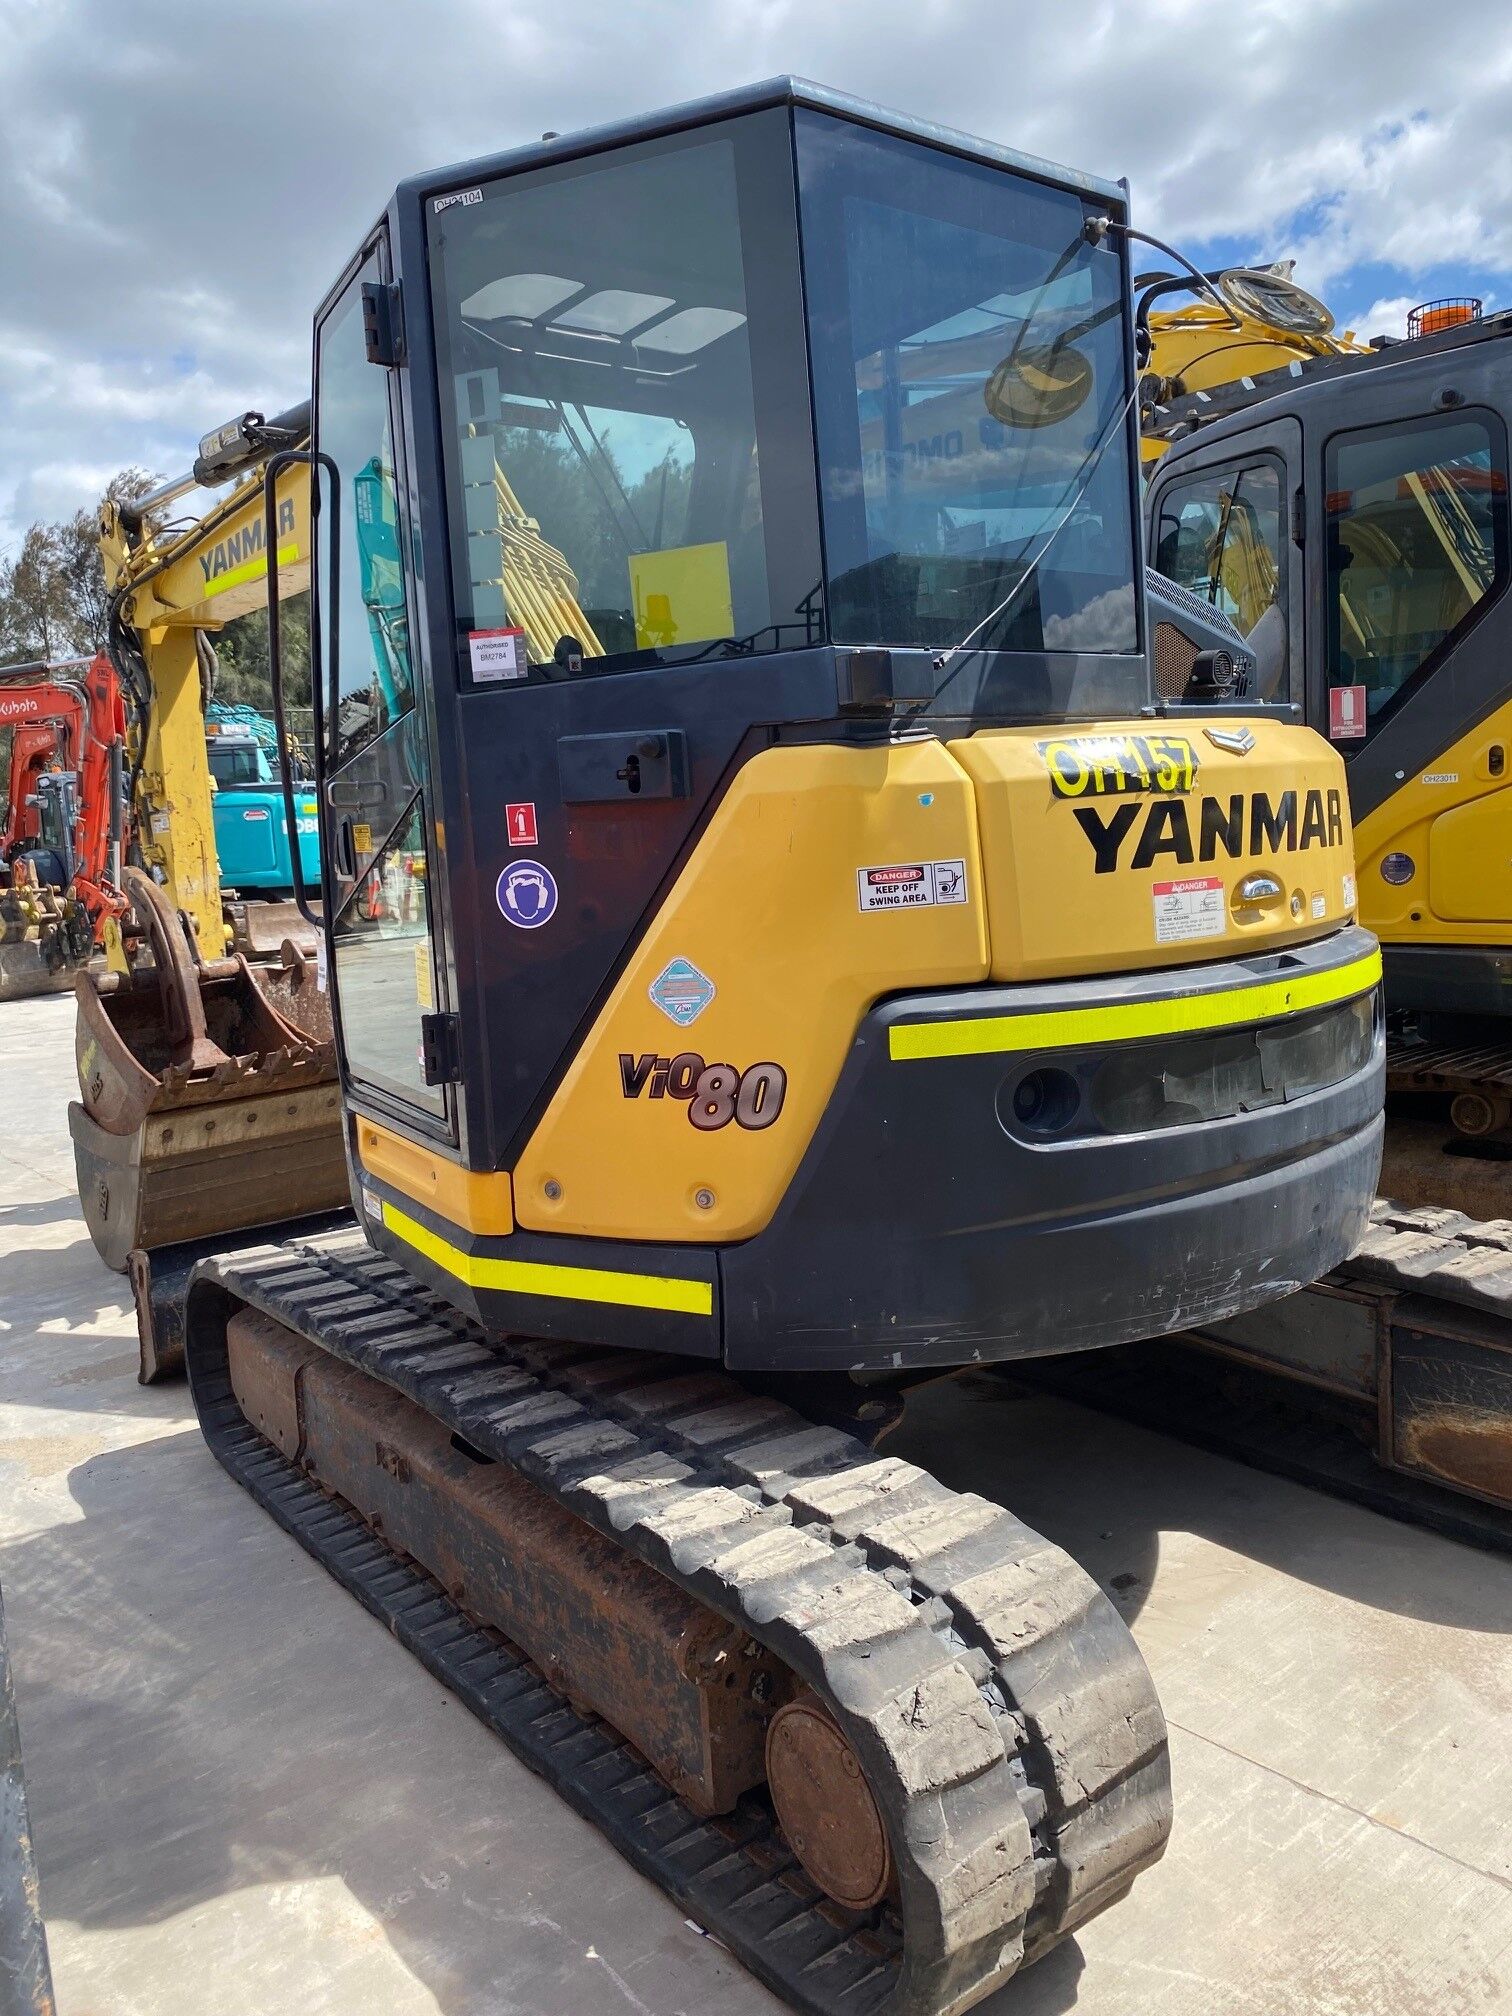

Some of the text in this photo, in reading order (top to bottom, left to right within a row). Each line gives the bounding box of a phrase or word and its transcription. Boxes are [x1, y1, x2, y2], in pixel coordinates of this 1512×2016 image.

[1072, 789, 1343, 874] YANMAR
[875, 871, 917, 881] DANGER
[875, 882, 919, 894] KEEP OFF
[1179, 881, 1208, 891] DANGER
[869, 893, 927, 906] SWING AREA
